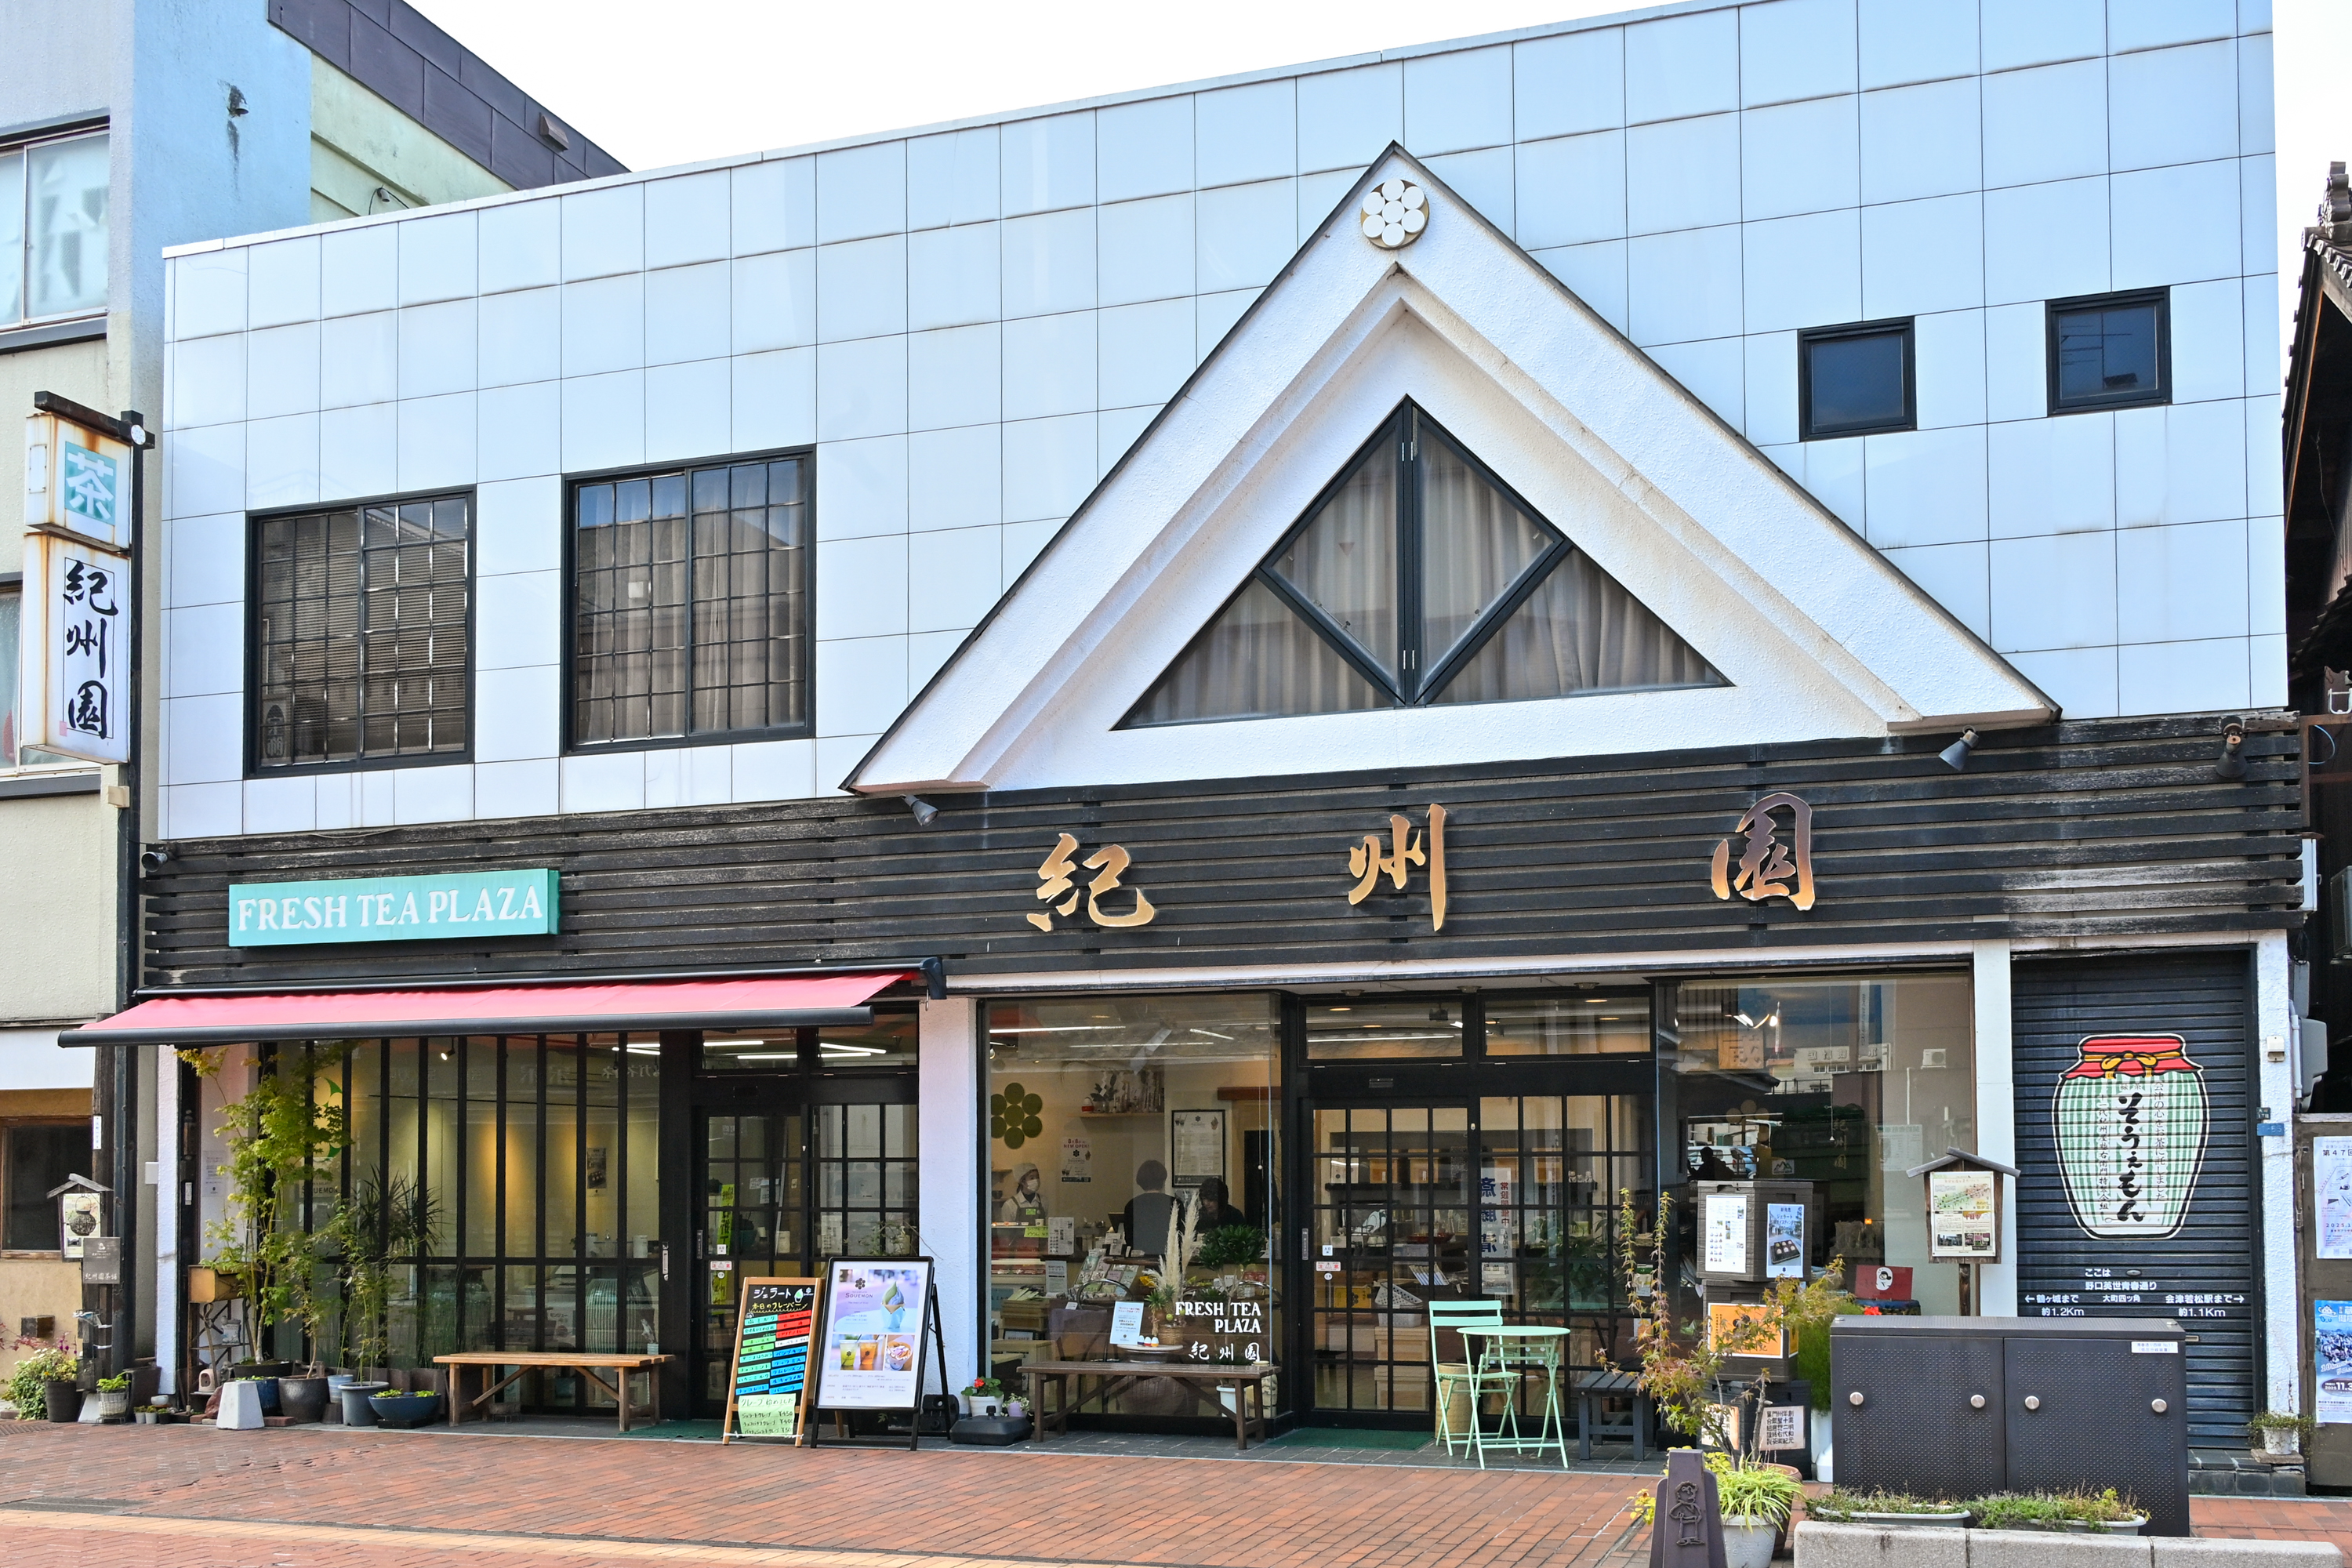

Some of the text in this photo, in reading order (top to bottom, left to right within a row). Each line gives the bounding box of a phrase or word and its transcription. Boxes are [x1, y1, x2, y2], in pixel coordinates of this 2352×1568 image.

[66, 451, 114, 520] 茶
[62, 559, 119, 740] 紀州園
[1025, 792, 1813, 933] 紀州園
[238, 885, 543, 931] FRESH TEA PLAZA
[2085, 1269, 2111, 1277] ここは
[753, 1287, 792, 1299] ジェラート
[2085, 1281, 2157, 1290] 野口英世青春通り
[2036, 1294, 2233, 1304] 鶴ヶ城まで 大町四ツ角 会津若松駅まで
[1175, 1301, 1261, 1316] FRESH TEA
[2042, 1307, 2226, 1317] 約1.2Km 約1.1Km
[1214, 1318, 1261, 1334] PLAZA
[1189, 1341, 1260, 1362] 紀州園
